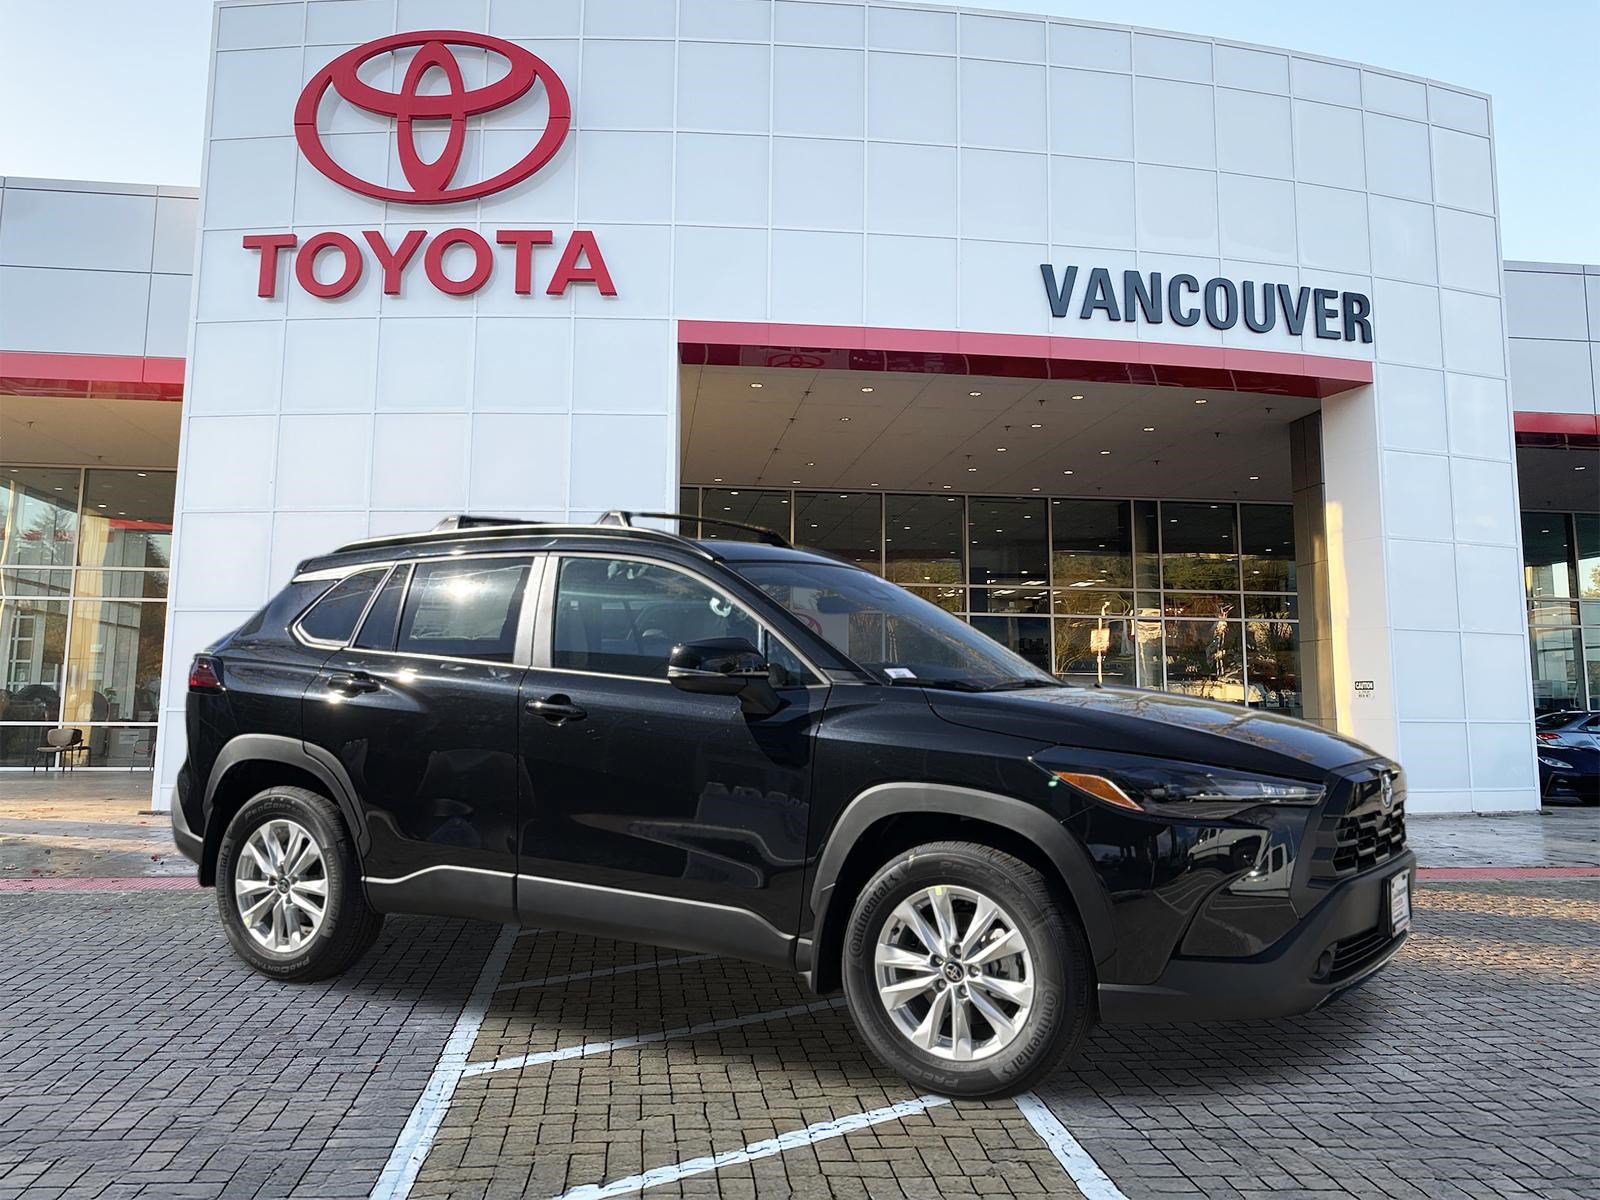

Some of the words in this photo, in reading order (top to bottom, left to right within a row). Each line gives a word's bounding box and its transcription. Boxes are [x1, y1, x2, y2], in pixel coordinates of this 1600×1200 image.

[242, 228, 618, 300] TOYOTA
[1041, 264, 1373, 343] VANCOUVER
[848, 878, 892, 958] Continental
[1011, 990, 1058, 1074] Continental
